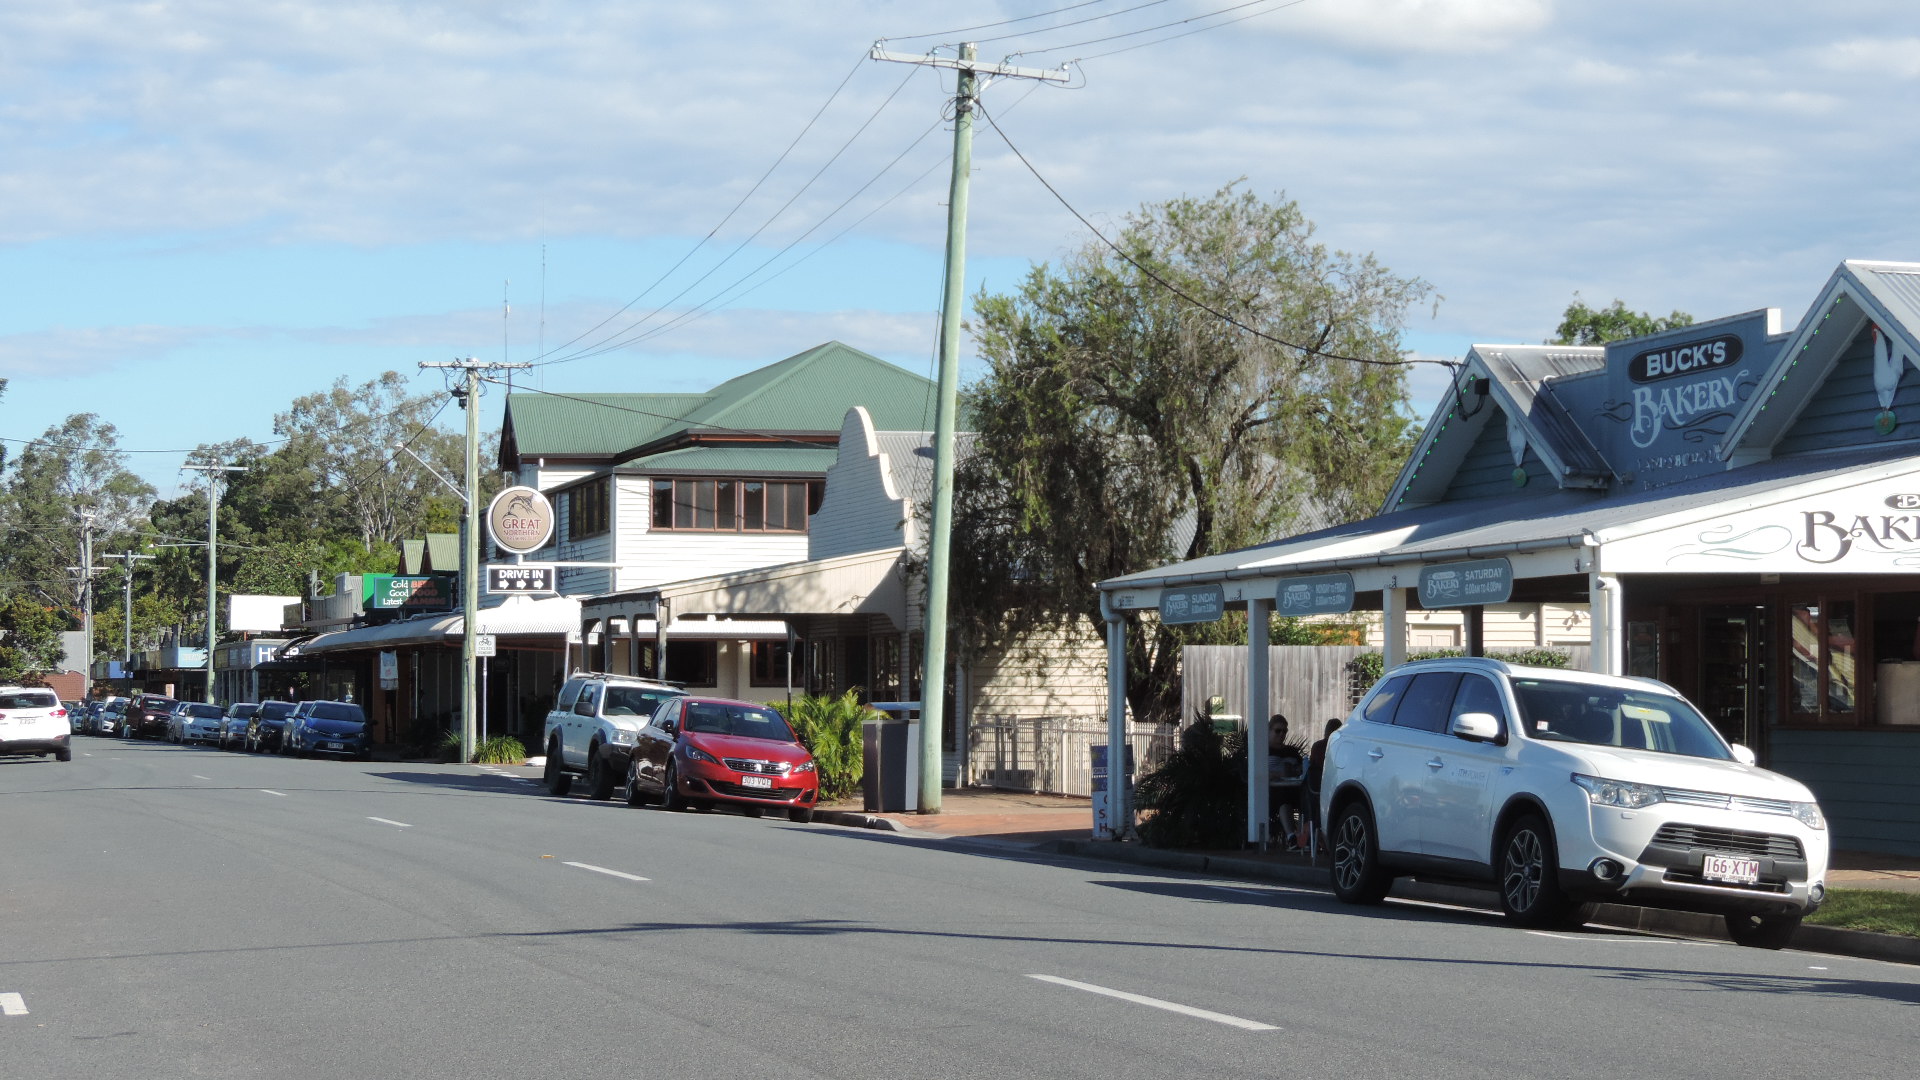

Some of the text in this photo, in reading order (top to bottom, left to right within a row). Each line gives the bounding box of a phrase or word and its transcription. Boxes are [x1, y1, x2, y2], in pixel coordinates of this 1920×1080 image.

[1646, 341, 1726, 377] BUCK'S
[1630, 369, 1749, 448] BAKERY
[502, 519, 542, 530] GREAT
[499, 569, 544, 579] DRIVE IN
[1464, 567, 1503, 581] SATURDAY
[391, 579, 408, 589] Cold
[1426, 579, 1460, 599] BAKERY
[389, 588, 409, 597] Good
[1191, 592, 1217, 604] SUNDAY
[383, 597, 403, 606] Latest
[1282, 591, 1311, 609] BAKERY
[1165, 600, 1189, 617] BAKERY
